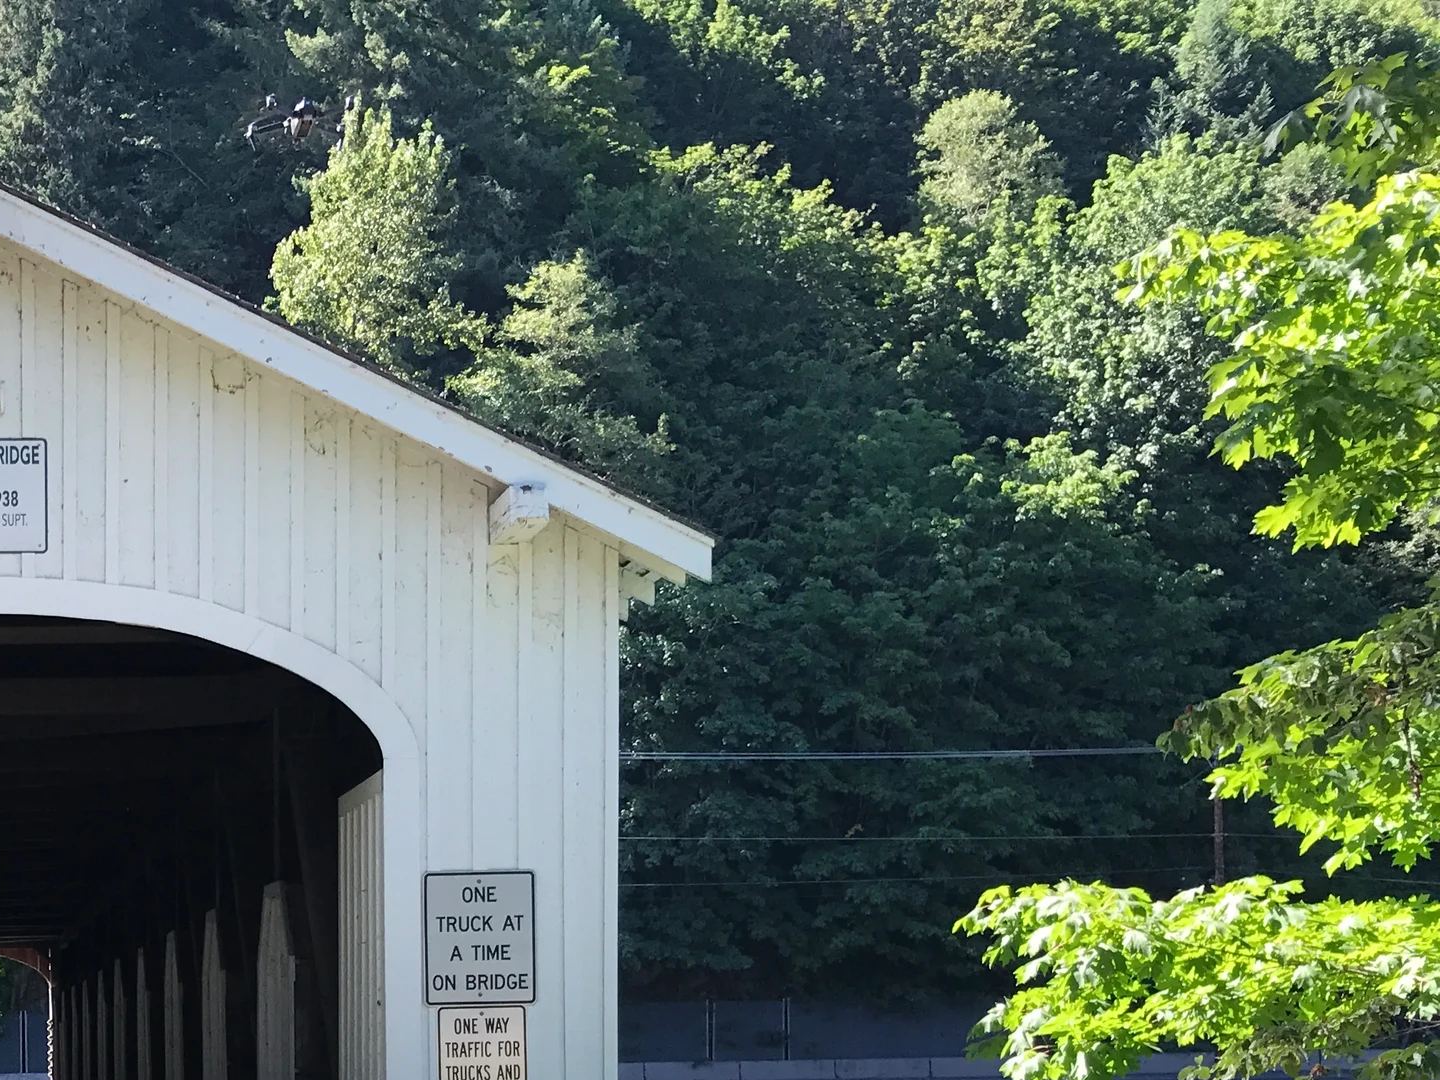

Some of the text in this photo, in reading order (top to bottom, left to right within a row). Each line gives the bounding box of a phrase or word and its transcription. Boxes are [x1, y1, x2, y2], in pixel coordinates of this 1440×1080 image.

[2, 514, 28, 526] SUPT.
[462, 886, 497, 903] ONE
[436, 915, 523, 932] TRUCK AT
[450, 945, 511, 961] A TIME
[433, 974, 528, 991] ON BRIDGE
[454, 1018, 509, 1034] ONE WAY
[445, 1041, 520, 1058] TRAFFIC FOR
[446, 1065, 520, 1080] TRUCKS AND
